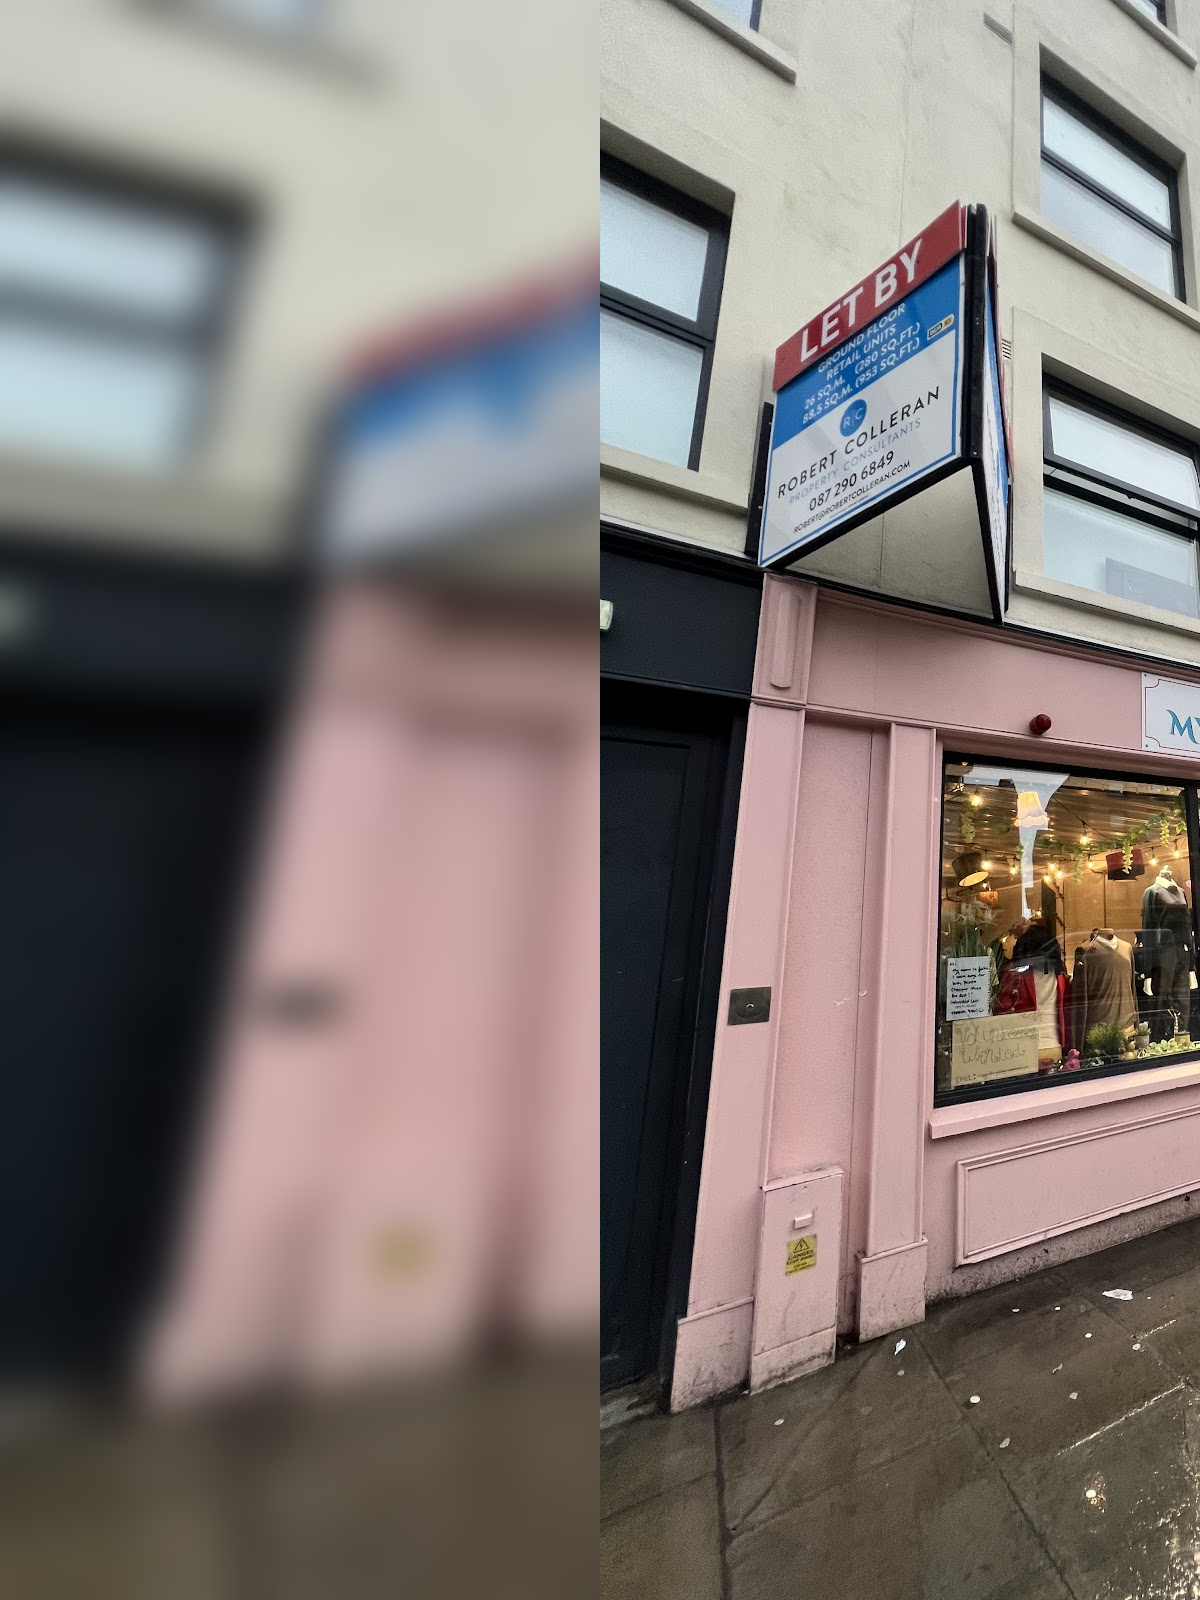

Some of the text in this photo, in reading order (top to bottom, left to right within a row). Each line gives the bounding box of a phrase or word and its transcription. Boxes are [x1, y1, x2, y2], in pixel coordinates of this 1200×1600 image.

[800, 238, 922, 362] LET BY
[818, 303, 905, 373] GROUND FLOOR
[803, 337, 920, 424] 88.5 SQ.M. (953 SQ.FT.)
[804, 322, 921, 411] 26 SQ.M. (280 SQ.FT.)
[827, 324, 896, 381] RETAIL UNITS
[778, 386, 940, 498] ROBERT COLLERAN
[789, 418, 921, 505] PROPERTY CONSULTANTS
[809, 489, 831, 511] 087
[834, 473, 857, 497] 290
[861, 450, 894, 480] 6849
[793, 460, 911, 533] ROBERT@ROBERTCOLLERAN.COM
